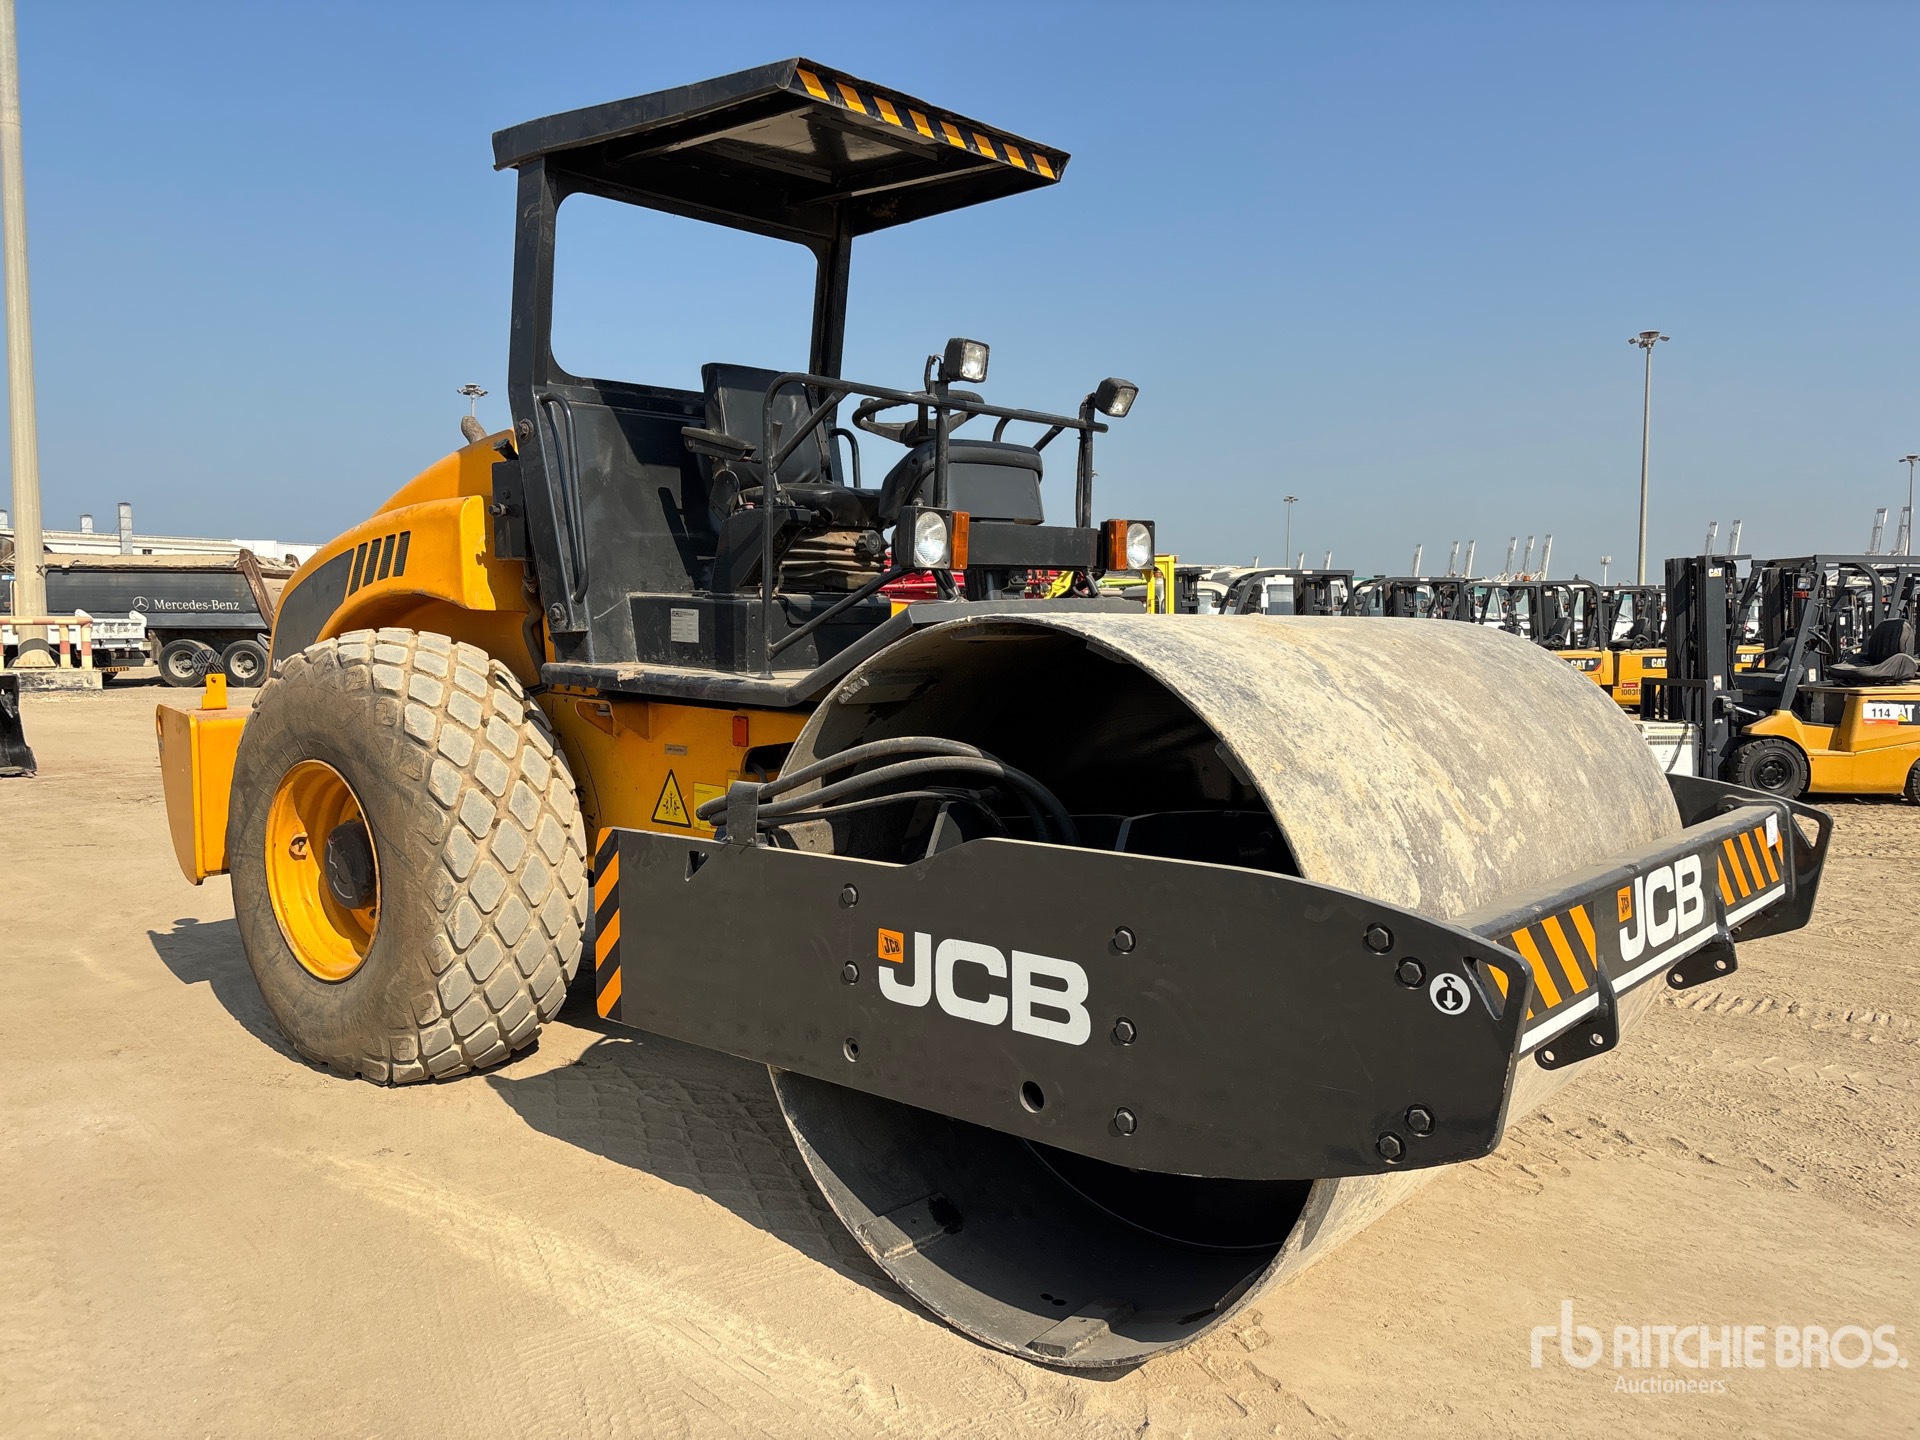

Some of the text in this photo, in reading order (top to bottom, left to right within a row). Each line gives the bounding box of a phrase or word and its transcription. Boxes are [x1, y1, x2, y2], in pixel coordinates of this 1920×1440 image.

[1709, 568, 1723, 577] CAT
[154, 599, 240, 610] Mercedes-Benz
[1651, 658, 1667, 668] CAT
[1740, 654, 1755, 663] CAT
[1570, 660, 1587, 670] CAT
[1871, 707, 1891, 718] 114
[1619, 853, 1705, 962] JCB
[883, 936, 901, 953] JCB
[878, 931, 1091, 1046] JCB
